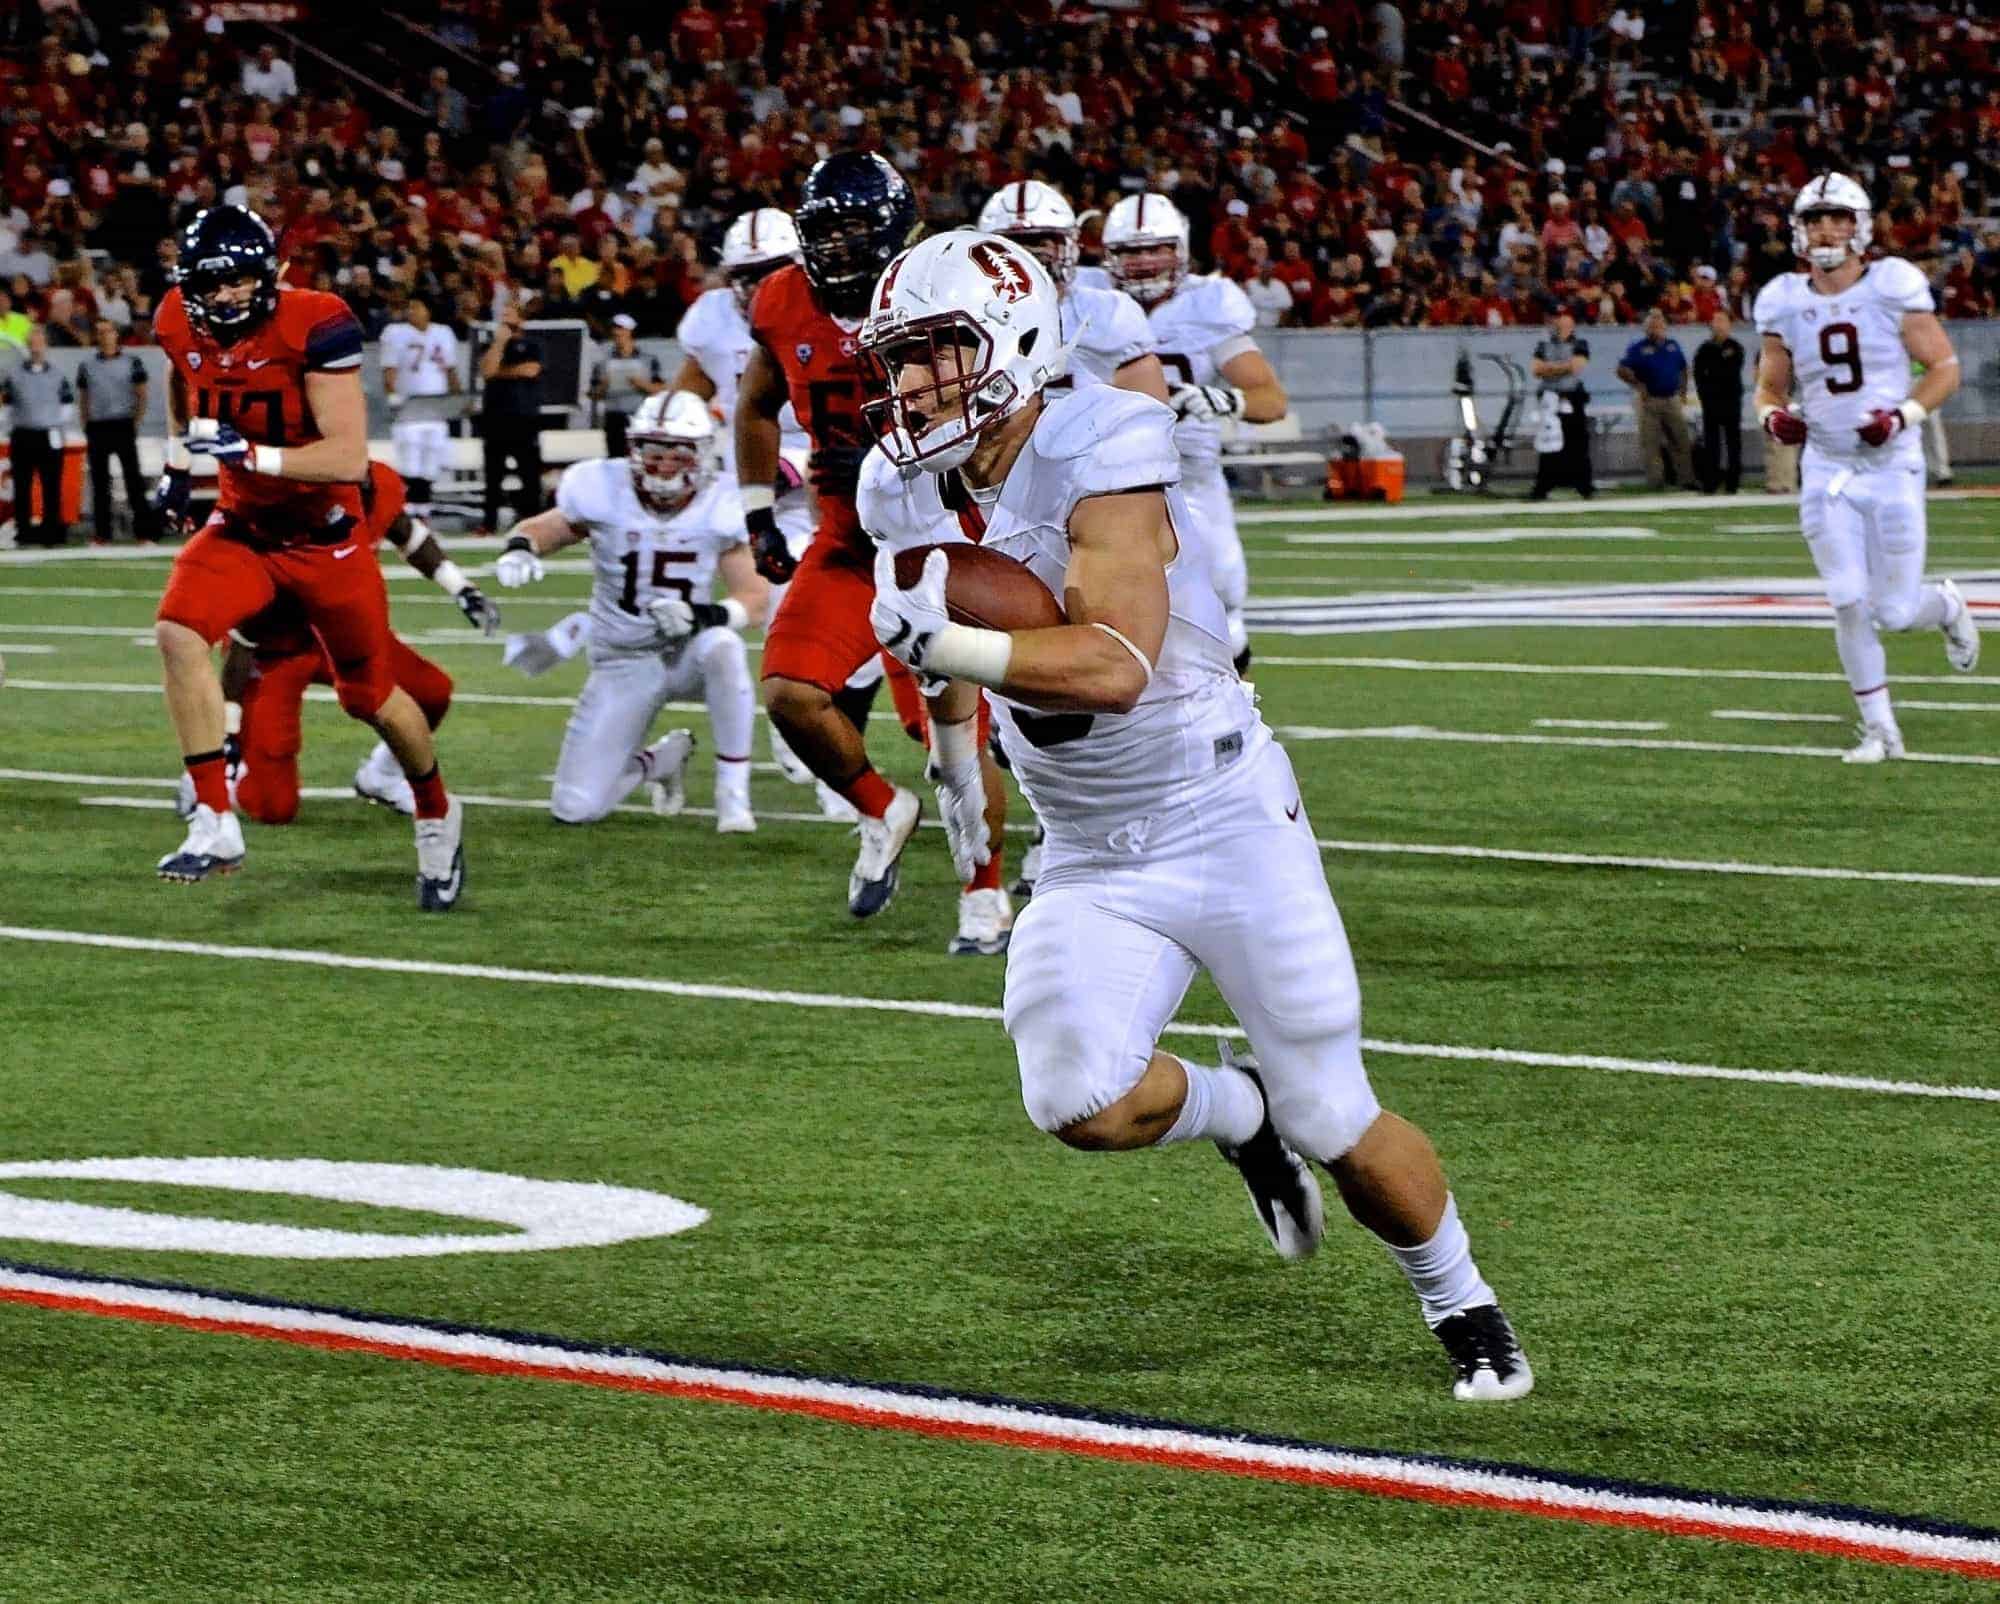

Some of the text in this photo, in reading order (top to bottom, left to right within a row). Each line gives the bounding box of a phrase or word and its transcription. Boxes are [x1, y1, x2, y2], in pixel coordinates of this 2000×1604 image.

[407, 343, 447, 373] 74
[1818, 322, 1864, 395] 9
[618, 550, 697, 617] 15
